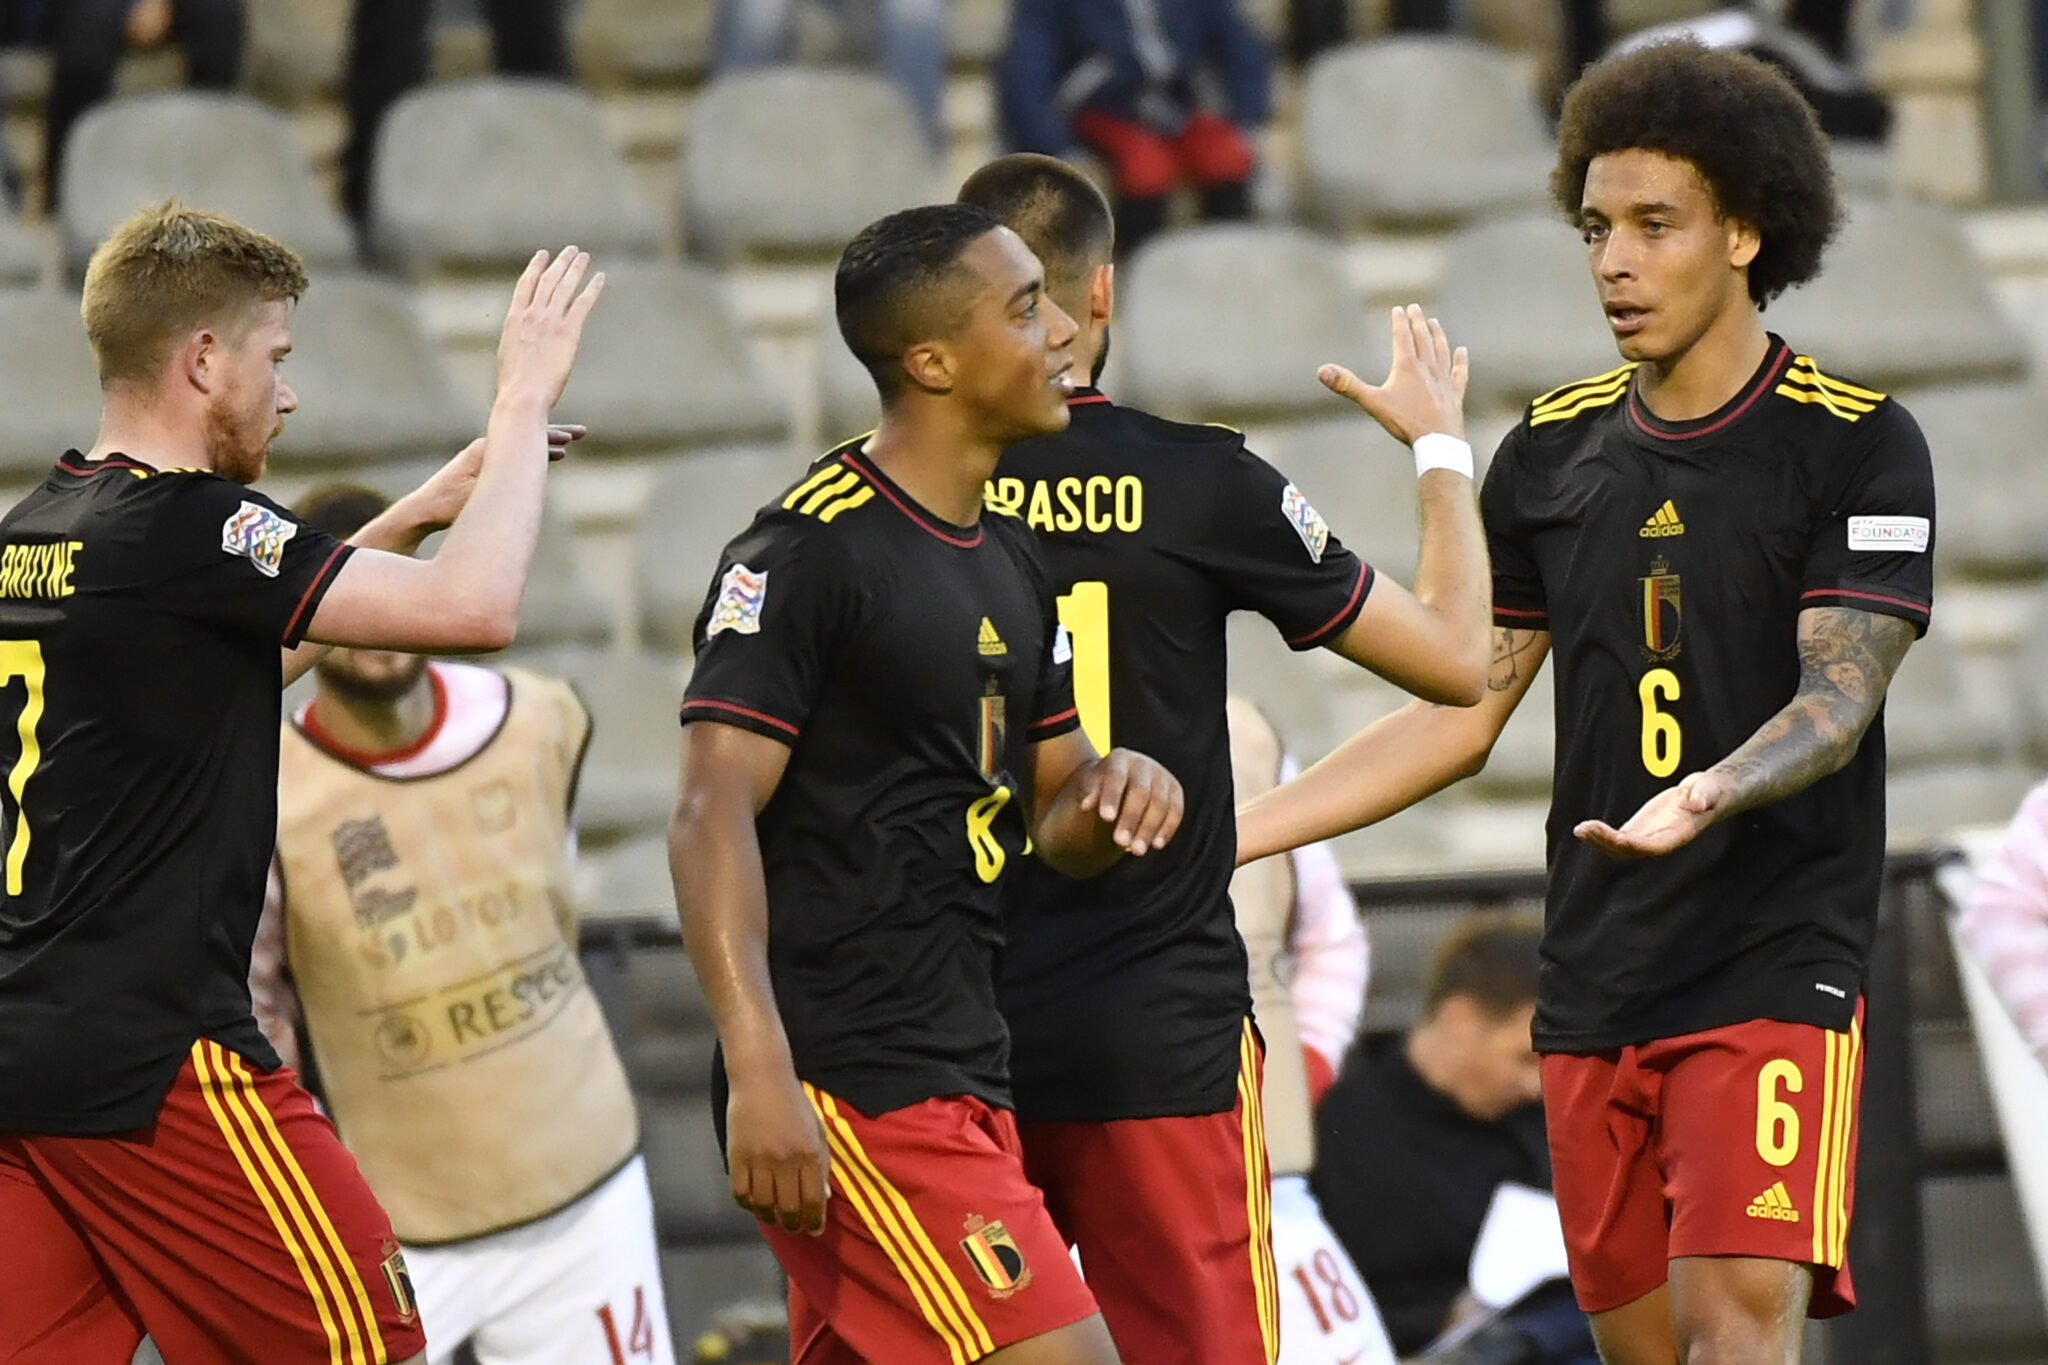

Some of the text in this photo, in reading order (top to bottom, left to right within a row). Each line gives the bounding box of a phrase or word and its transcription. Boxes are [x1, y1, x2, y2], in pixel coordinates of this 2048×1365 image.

[1639, 523, 1685, 538] adidas
[1638, 668, 1682, 778] 6
[0, 640, 46, 896] 7
[1755, 1059, 1803, 1167] 6
[1746, 1204, 1799, 1222] adidas
[597, 1286, 654, 1365] 14
[1291, 1248, 1359, 1336] 18
